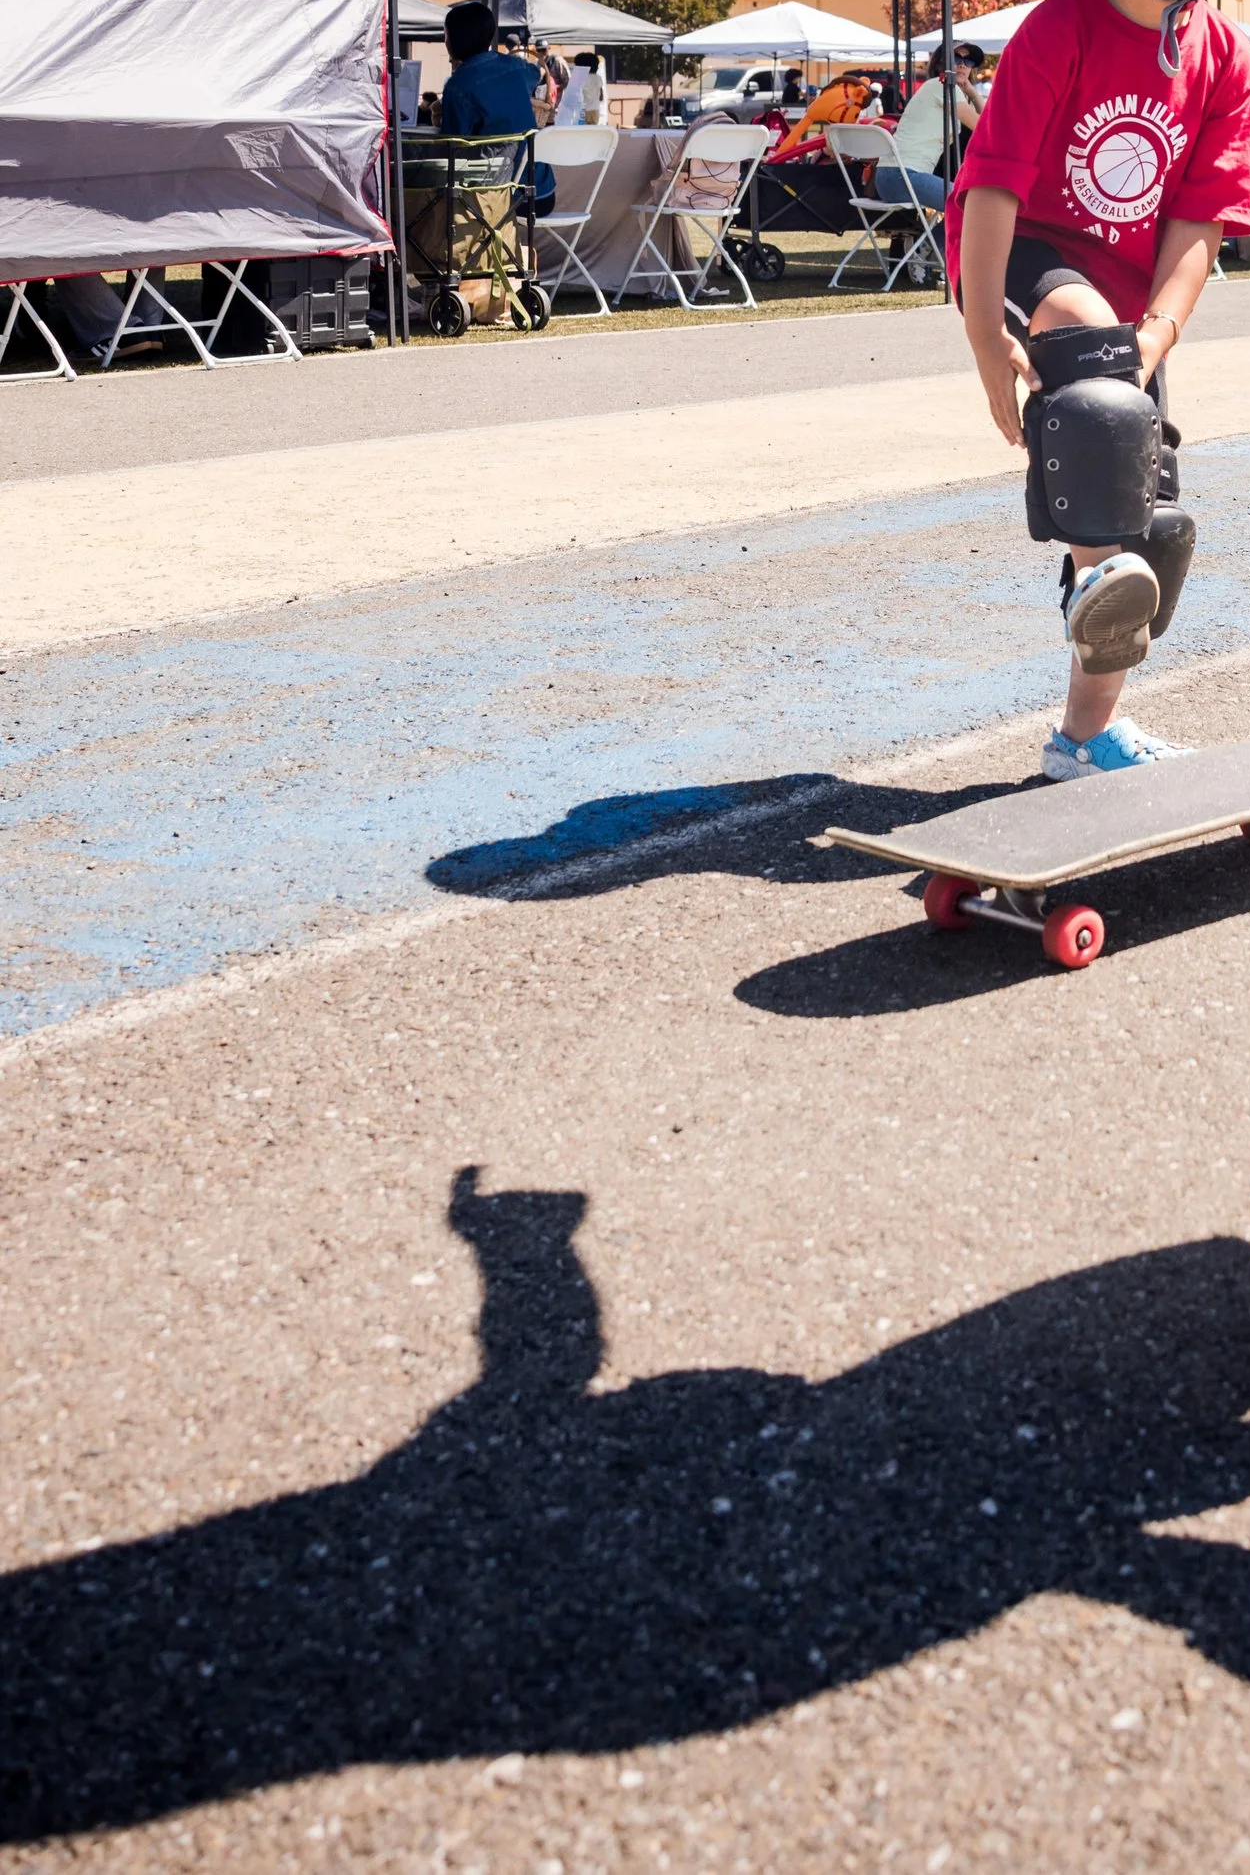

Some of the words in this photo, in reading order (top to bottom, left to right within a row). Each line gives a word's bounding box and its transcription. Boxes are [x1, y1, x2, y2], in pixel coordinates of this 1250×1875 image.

[1073, 94, 1138, 141] DAMIAN
[1074, 178, 1129, 218] BASKETBALL
[1133, 193, 1159, 216] CAMP
